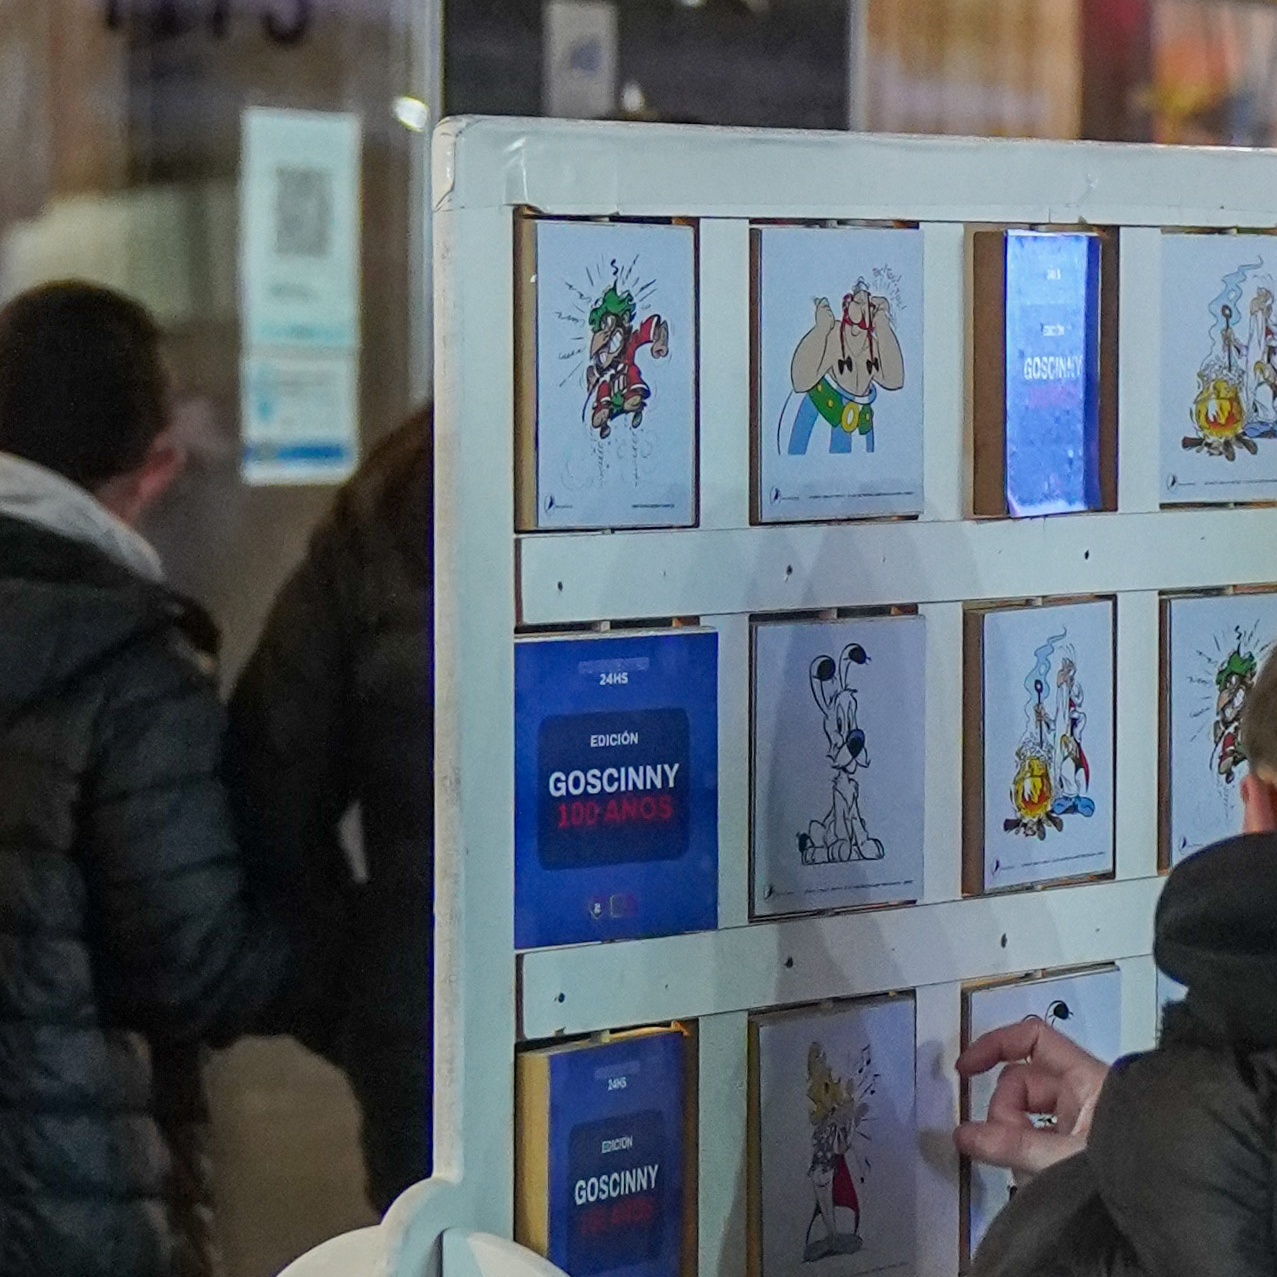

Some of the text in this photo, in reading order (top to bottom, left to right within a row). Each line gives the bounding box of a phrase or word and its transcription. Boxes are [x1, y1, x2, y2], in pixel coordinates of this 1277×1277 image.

[600, 672, 628, 686] 24HS
[590, 730, 639, 748] EDICIÓN
[549, 763, 679, 797] GOSCINNY
[558, 801, 600, 827] 100
[574, 1164, 659, 1205] GOSCINNY
